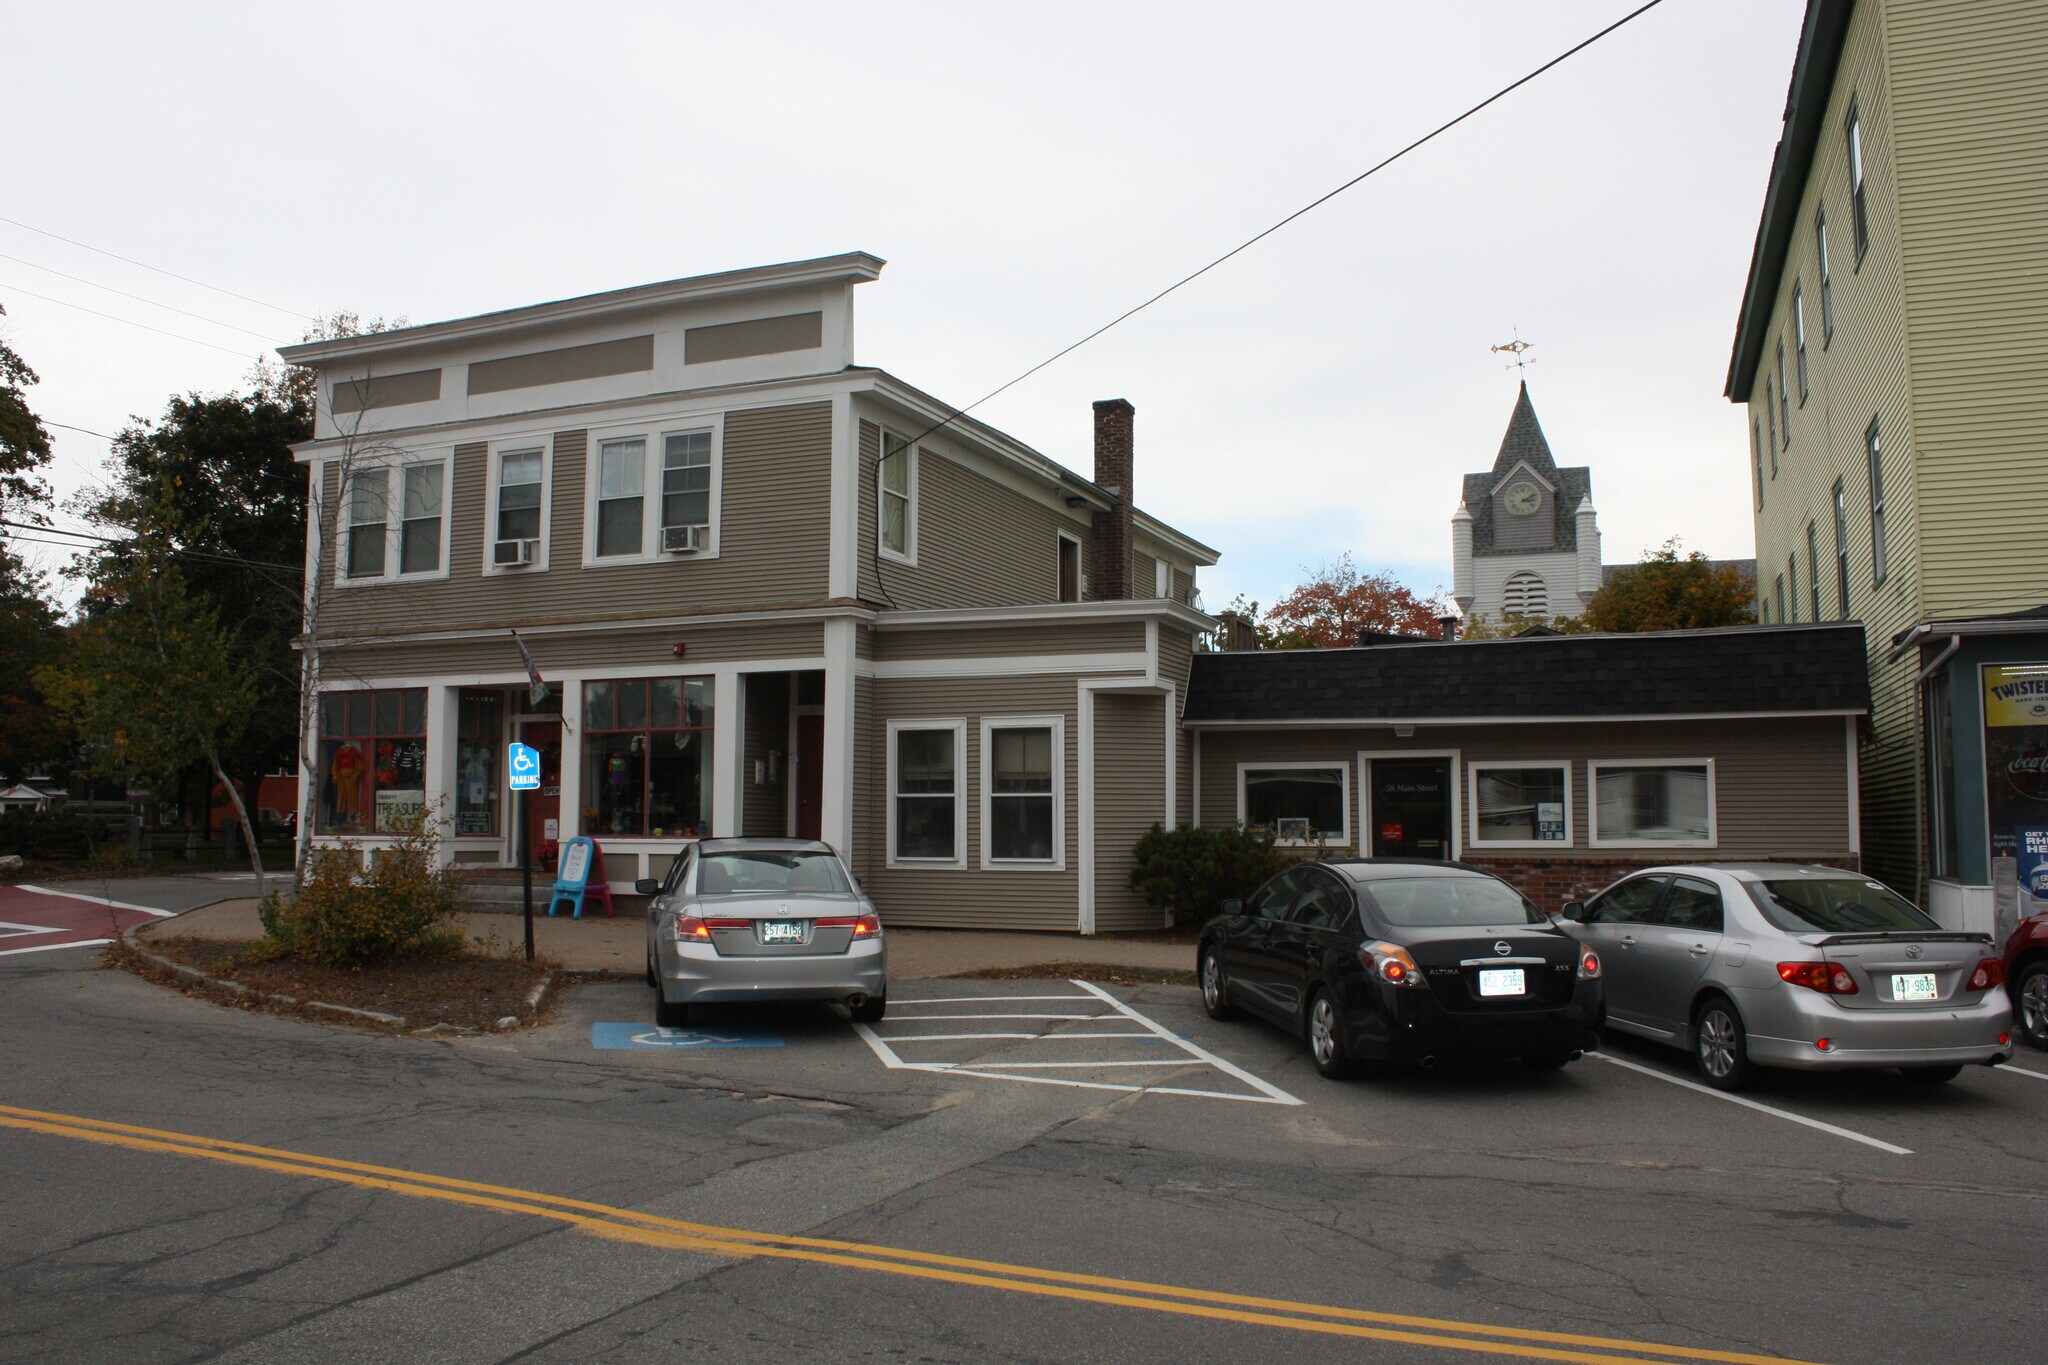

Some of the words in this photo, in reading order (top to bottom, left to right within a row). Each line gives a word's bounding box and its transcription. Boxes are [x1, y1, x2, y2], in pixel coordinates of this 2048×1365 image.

[511, 775, 540, 785] PARKING
[1396, 784, 1414, 792] Main
[1416, 784, 1438, 792] Street
[765, 925, 779, 936] 257
[1483, 976, 1498, 988] 452
[1503, 975, 1523, 987] 2359
